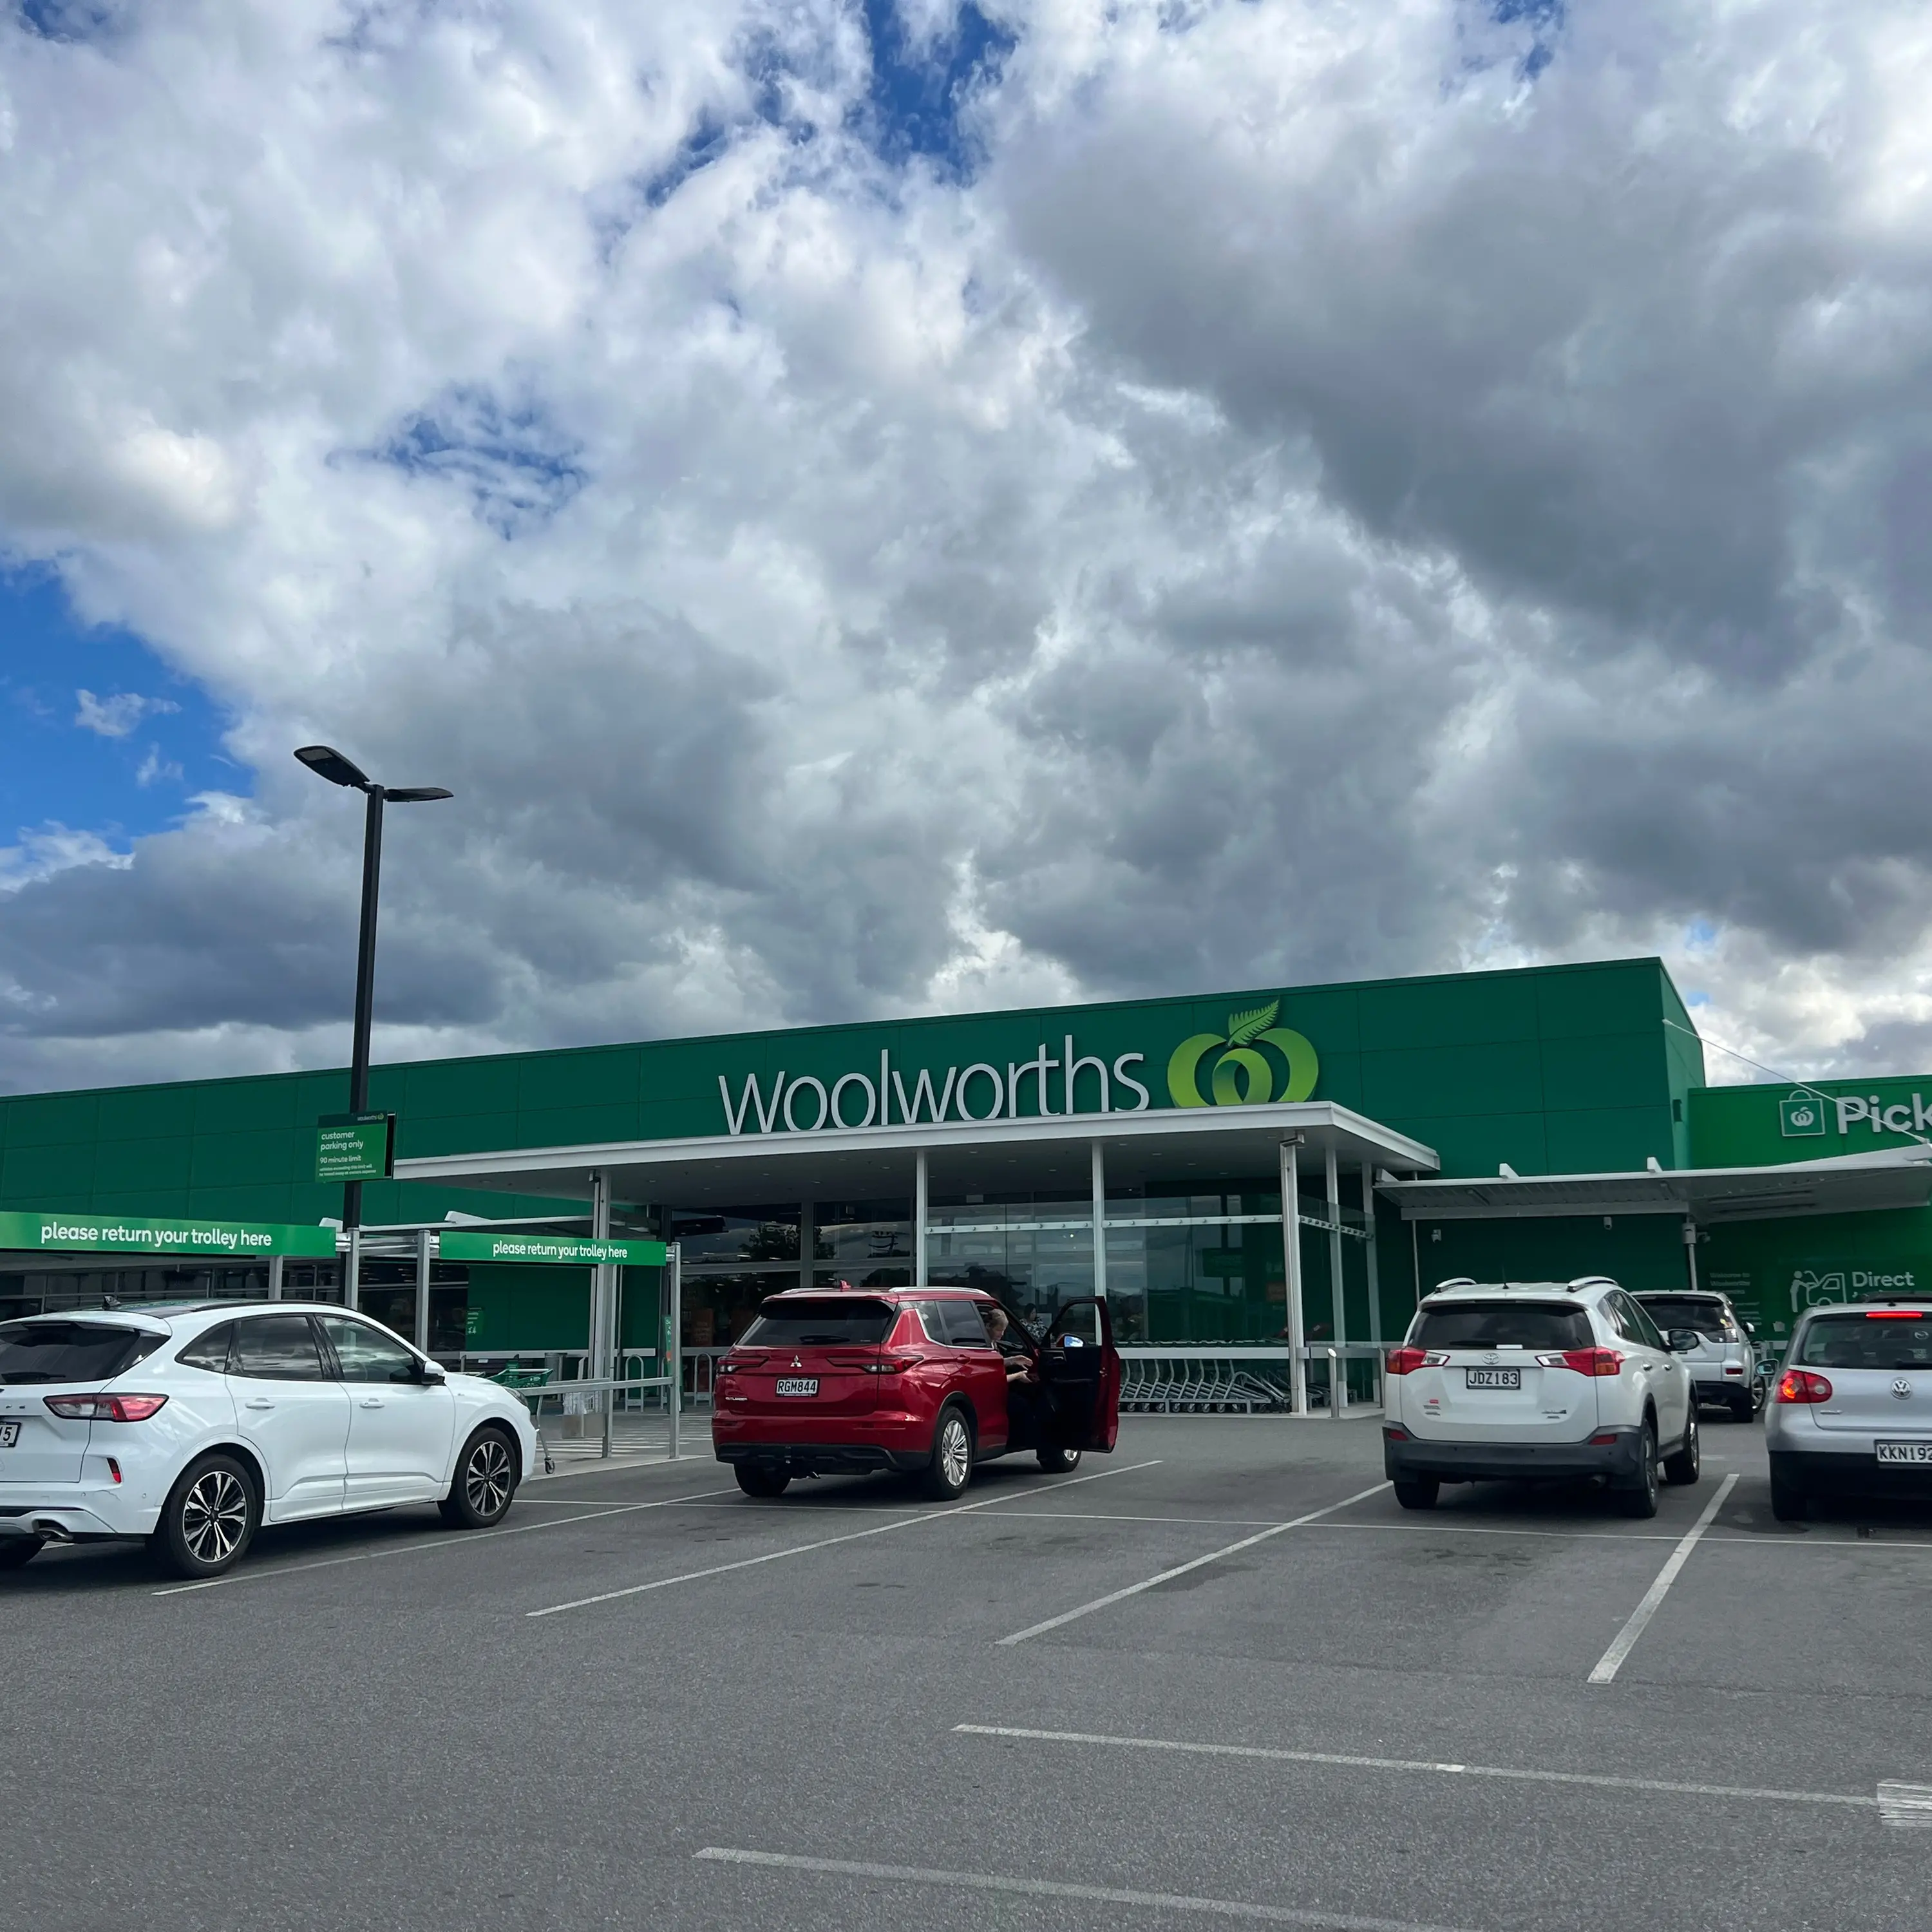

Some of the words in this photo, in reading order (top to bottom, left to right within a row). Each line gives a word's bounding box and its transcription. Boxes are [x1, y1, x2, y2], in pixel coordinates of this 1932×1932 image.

[717, 1034, 1151, 1135] Woolworths
[1835, 1093, 1932, 1134] Pick
[321, 1132, 355, 1140] customer
[320, 1141, 347, 1152] parking
[348, 1139, 364, 1150] only
[41, 1221, 99, 1244] please
[102, 1225, 152, 1243] return
[154, 1229, 189, 1248] your
[191, 1227, 238, 1250] trolley
[240, 1229, 272, 1247] here
[493, 1240, 526, 1257] please
[527, 1242, 557, 1256] return
[558, 1246, 578, 1260] your
[579, 1244, 607, 1261] trolley
[608, 1244, 628, 1258] here
[1852, 1271, 1915, 1287] Direct
[1469, 1372, 1518, 1385] JDZ183
[777, 1380, 817, 1394] RGM844
[1879, 1445, 1932, 1461] KKN192
